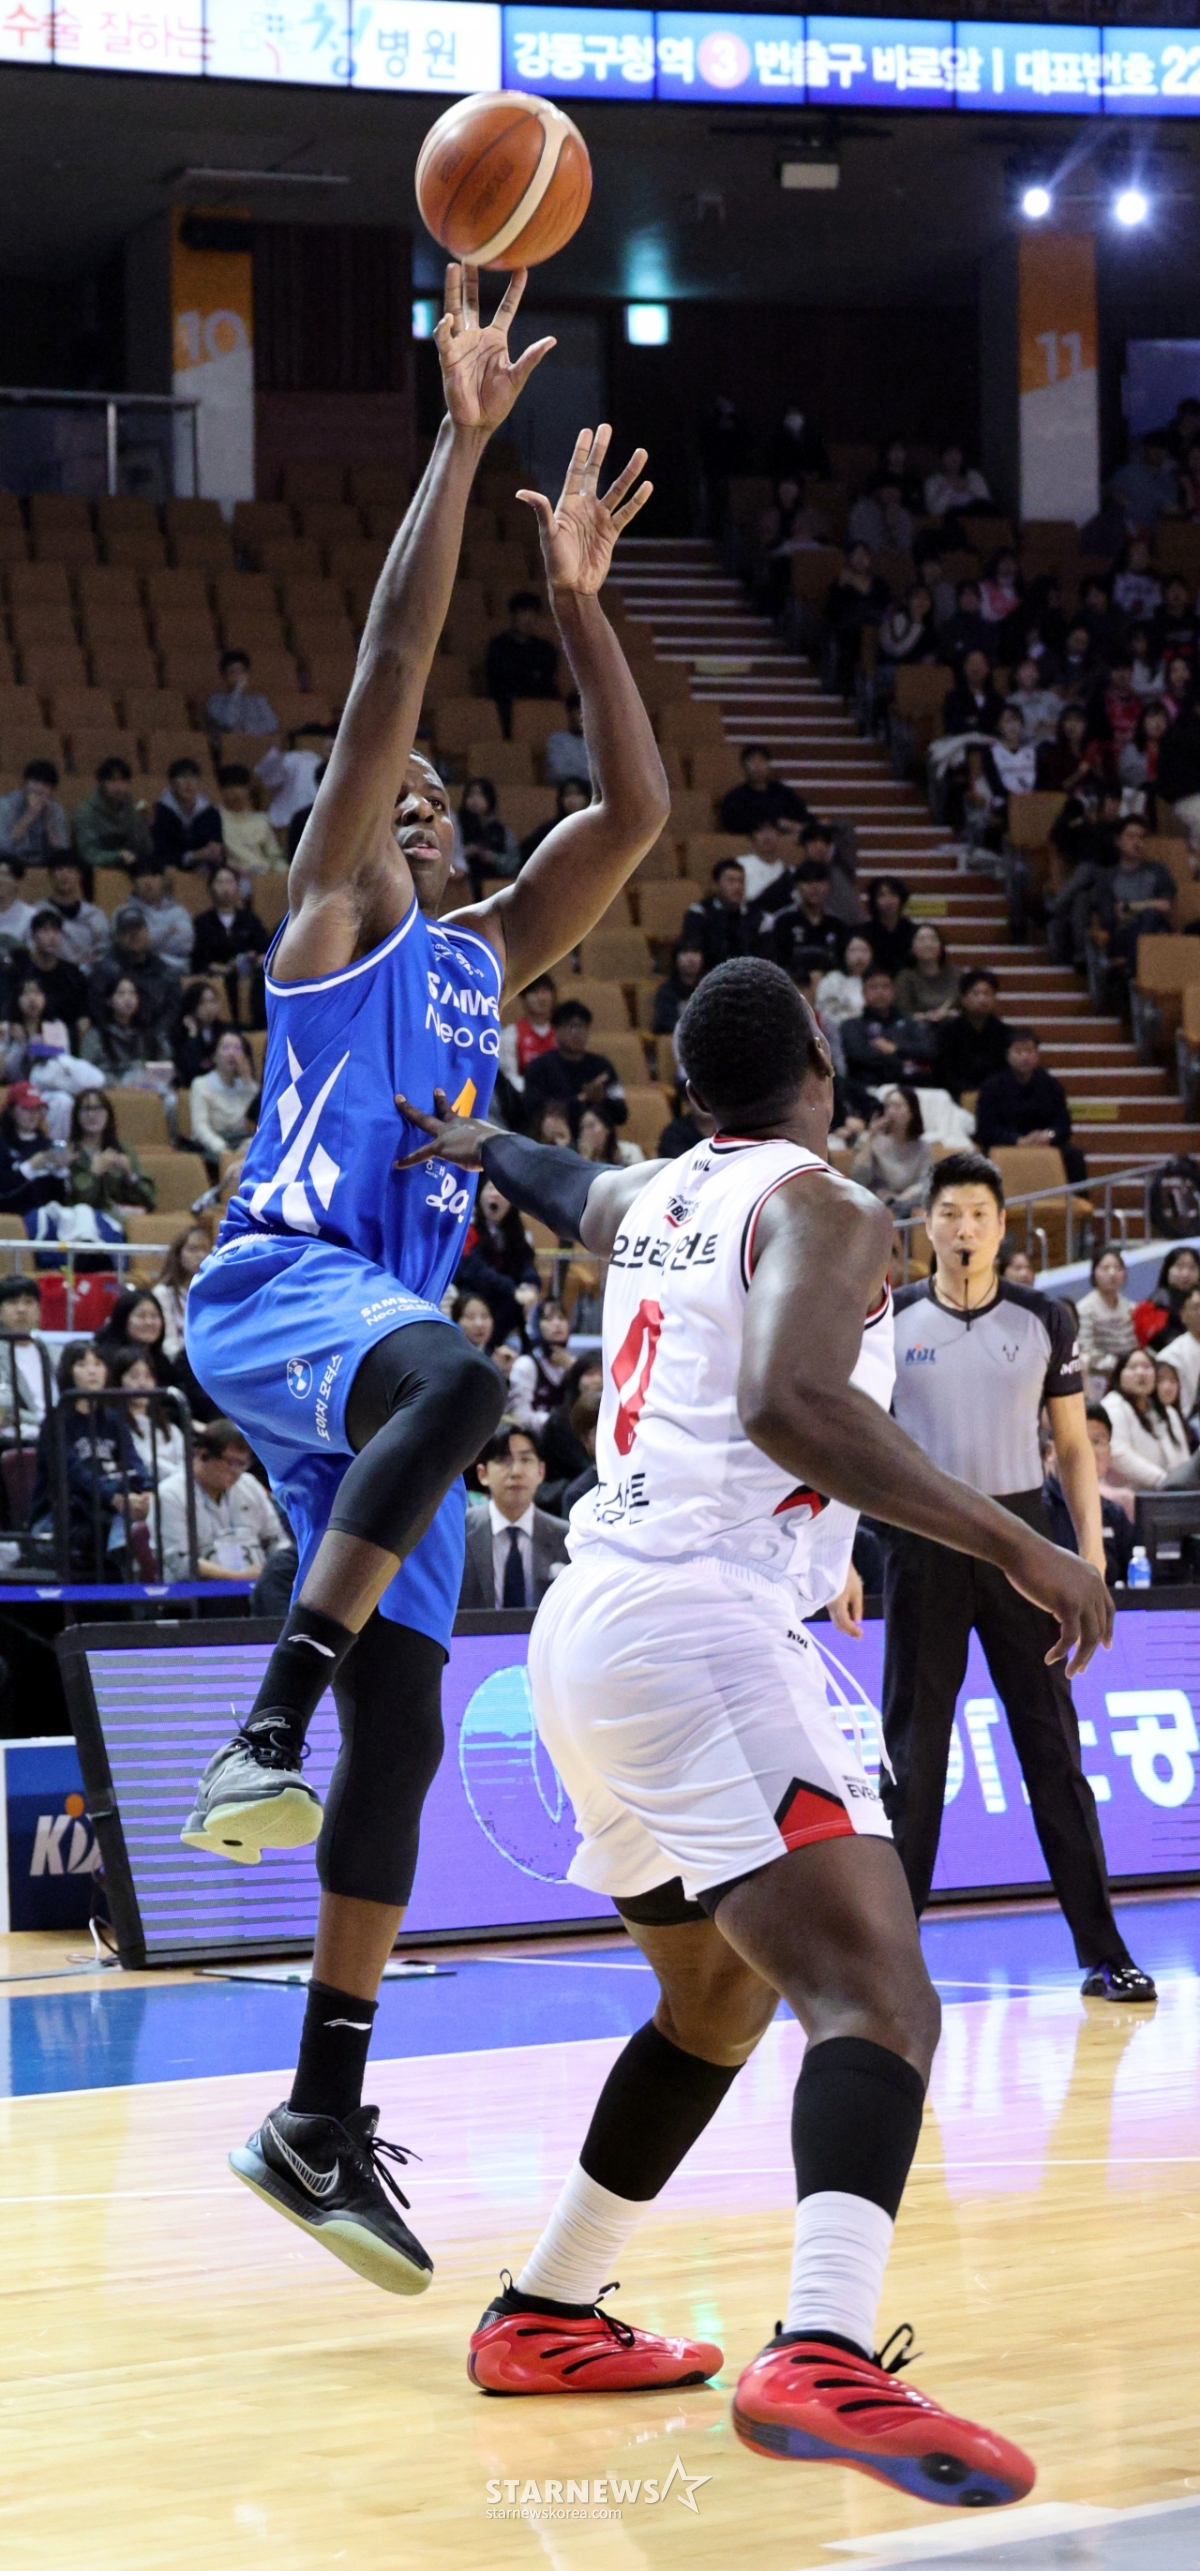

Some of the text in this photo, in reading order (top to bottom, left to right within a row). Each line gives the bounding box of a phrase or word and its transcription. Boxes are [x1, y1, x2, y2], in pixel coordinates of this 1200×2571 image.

[3, 3, 83, 50] 수술
[100, 11, 215, 61] 잘하는
[513, 32, 694, 84] 강동구청역
[710, 38, 738, 78] 3
[754, 38, 867, 89] 번출구
[871, 43, 984, 93] 바로앞
[1015, 48, 1159, 96] 대표번호
[177, 308, 250, 362] 10
[1035, 330, 1082, 383] 11
[425, 1003, 474, 1048] Neo
[365, 1308, 397, 1327] Neo
[314, 1354, 344, 1441] 도이치 모터스
